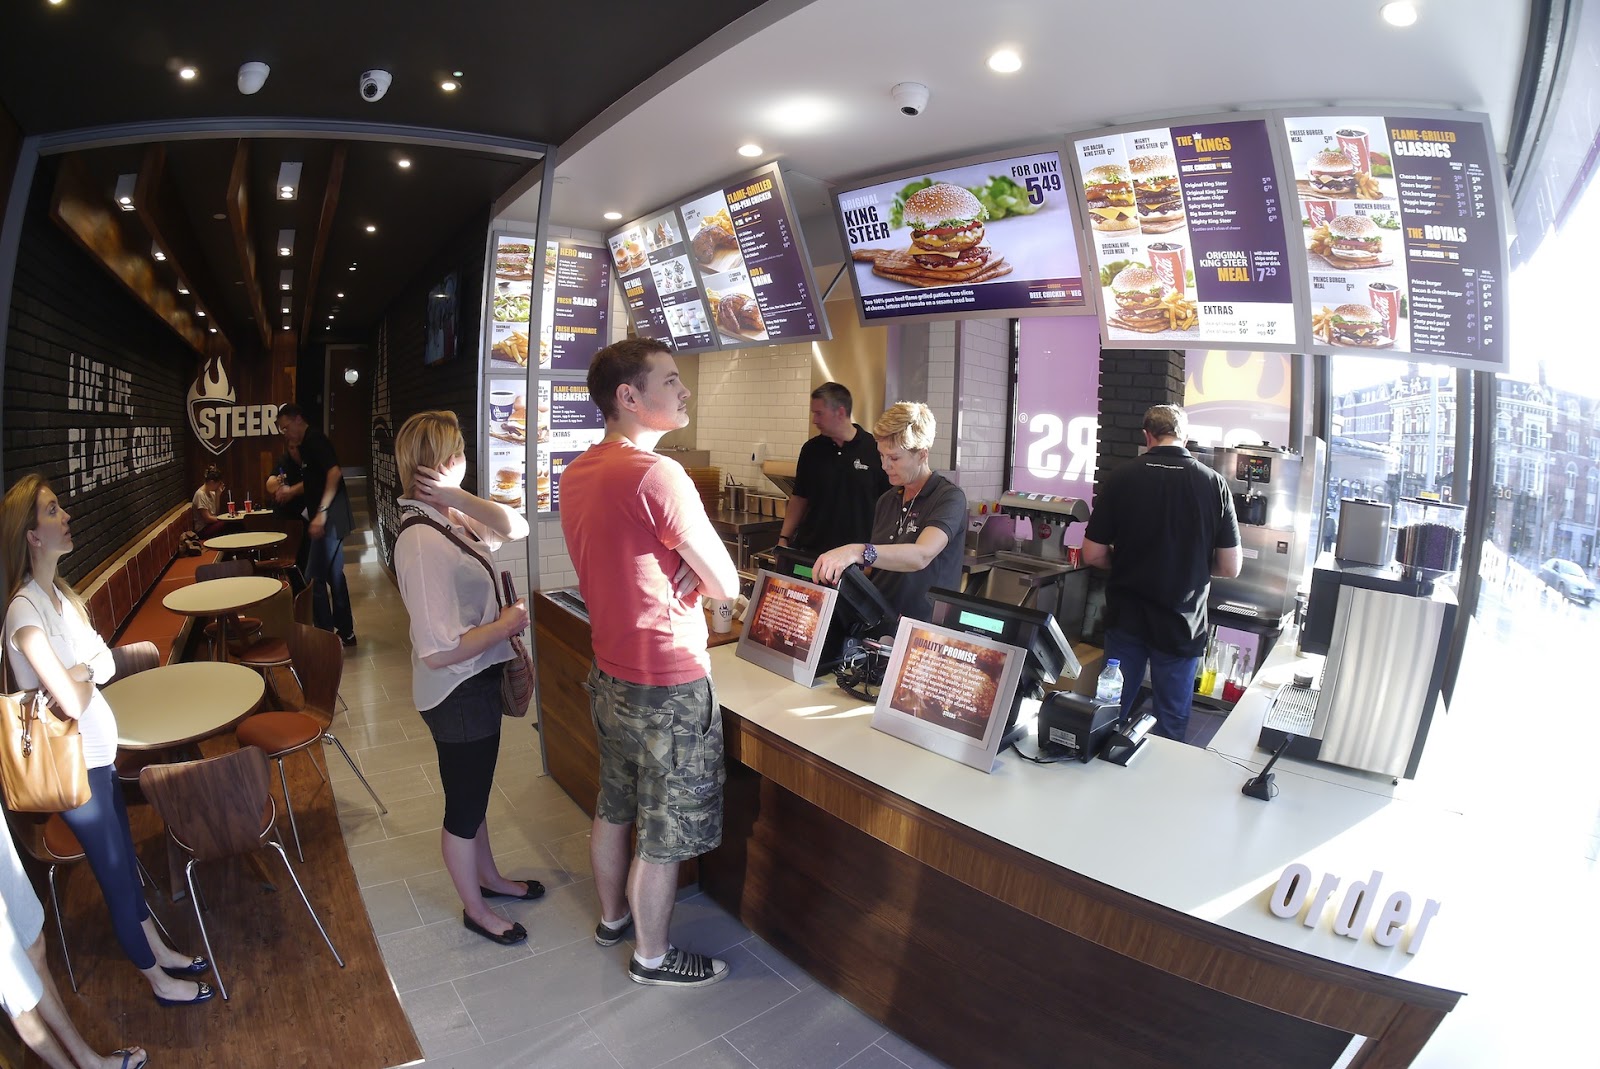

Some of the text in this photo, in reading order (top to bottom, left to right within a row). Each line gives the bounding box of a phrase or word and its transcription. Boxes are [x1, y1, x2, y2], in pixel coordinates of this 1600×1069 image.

[1391, 129, 1456, 142] FLAME-GRILLED
[1176, 136, 1232, 153] THE KINGS
[1394, 141, 1451, 158] CLASSICS
[1011, 161, 1057, 177] FOR ONLY
[727, 179, 773, 204] FLAME-GRILLED
[751, 191, 772, 205] CHICKEN
[842, 194, 879, 210] ORIGINAL
[844, 206, 879, 227] KING
[848, 222, 890, 244] STEER
[1407, 225, 1467, 243] THE ROYALS
[560, 248, 577, 257] HERO
[1206, 251, 1247, 259] ORIGINAL
[1223, 259, 1248, 267] STEER
[751, 273, 773, 287] DRINK
[1217, 268, 1250, 282] MEAL
[918, 293, 933, 301] grilled
[1043, 290, 1066, 298] CHICKEN
[573, 297, 597, 307] SALADS
[1204, 306, 1233, 315] EXTRAS
[555, 332, 576, 342] CHIPS
[68, 352, 104, 412] LIVE
[553, 393, 590, 401] BREAKFAST
[68, 428, 129, 497] FLAME
[787, 589, 810, 603] PROMISE
[914, 637, 978, 664] QUALITY PROMISE
[955, 661, 972, 671] making
[944, 679, 961, 689] quality
[950, 673, 963, 681] fresh
[968, 672, 986, 683] burgers
[929, 680, 953, 691] experience
[962, 690, 973, 698] take
[953, 701, 966, 709] short
[1270, 863, 1441, 955] order
